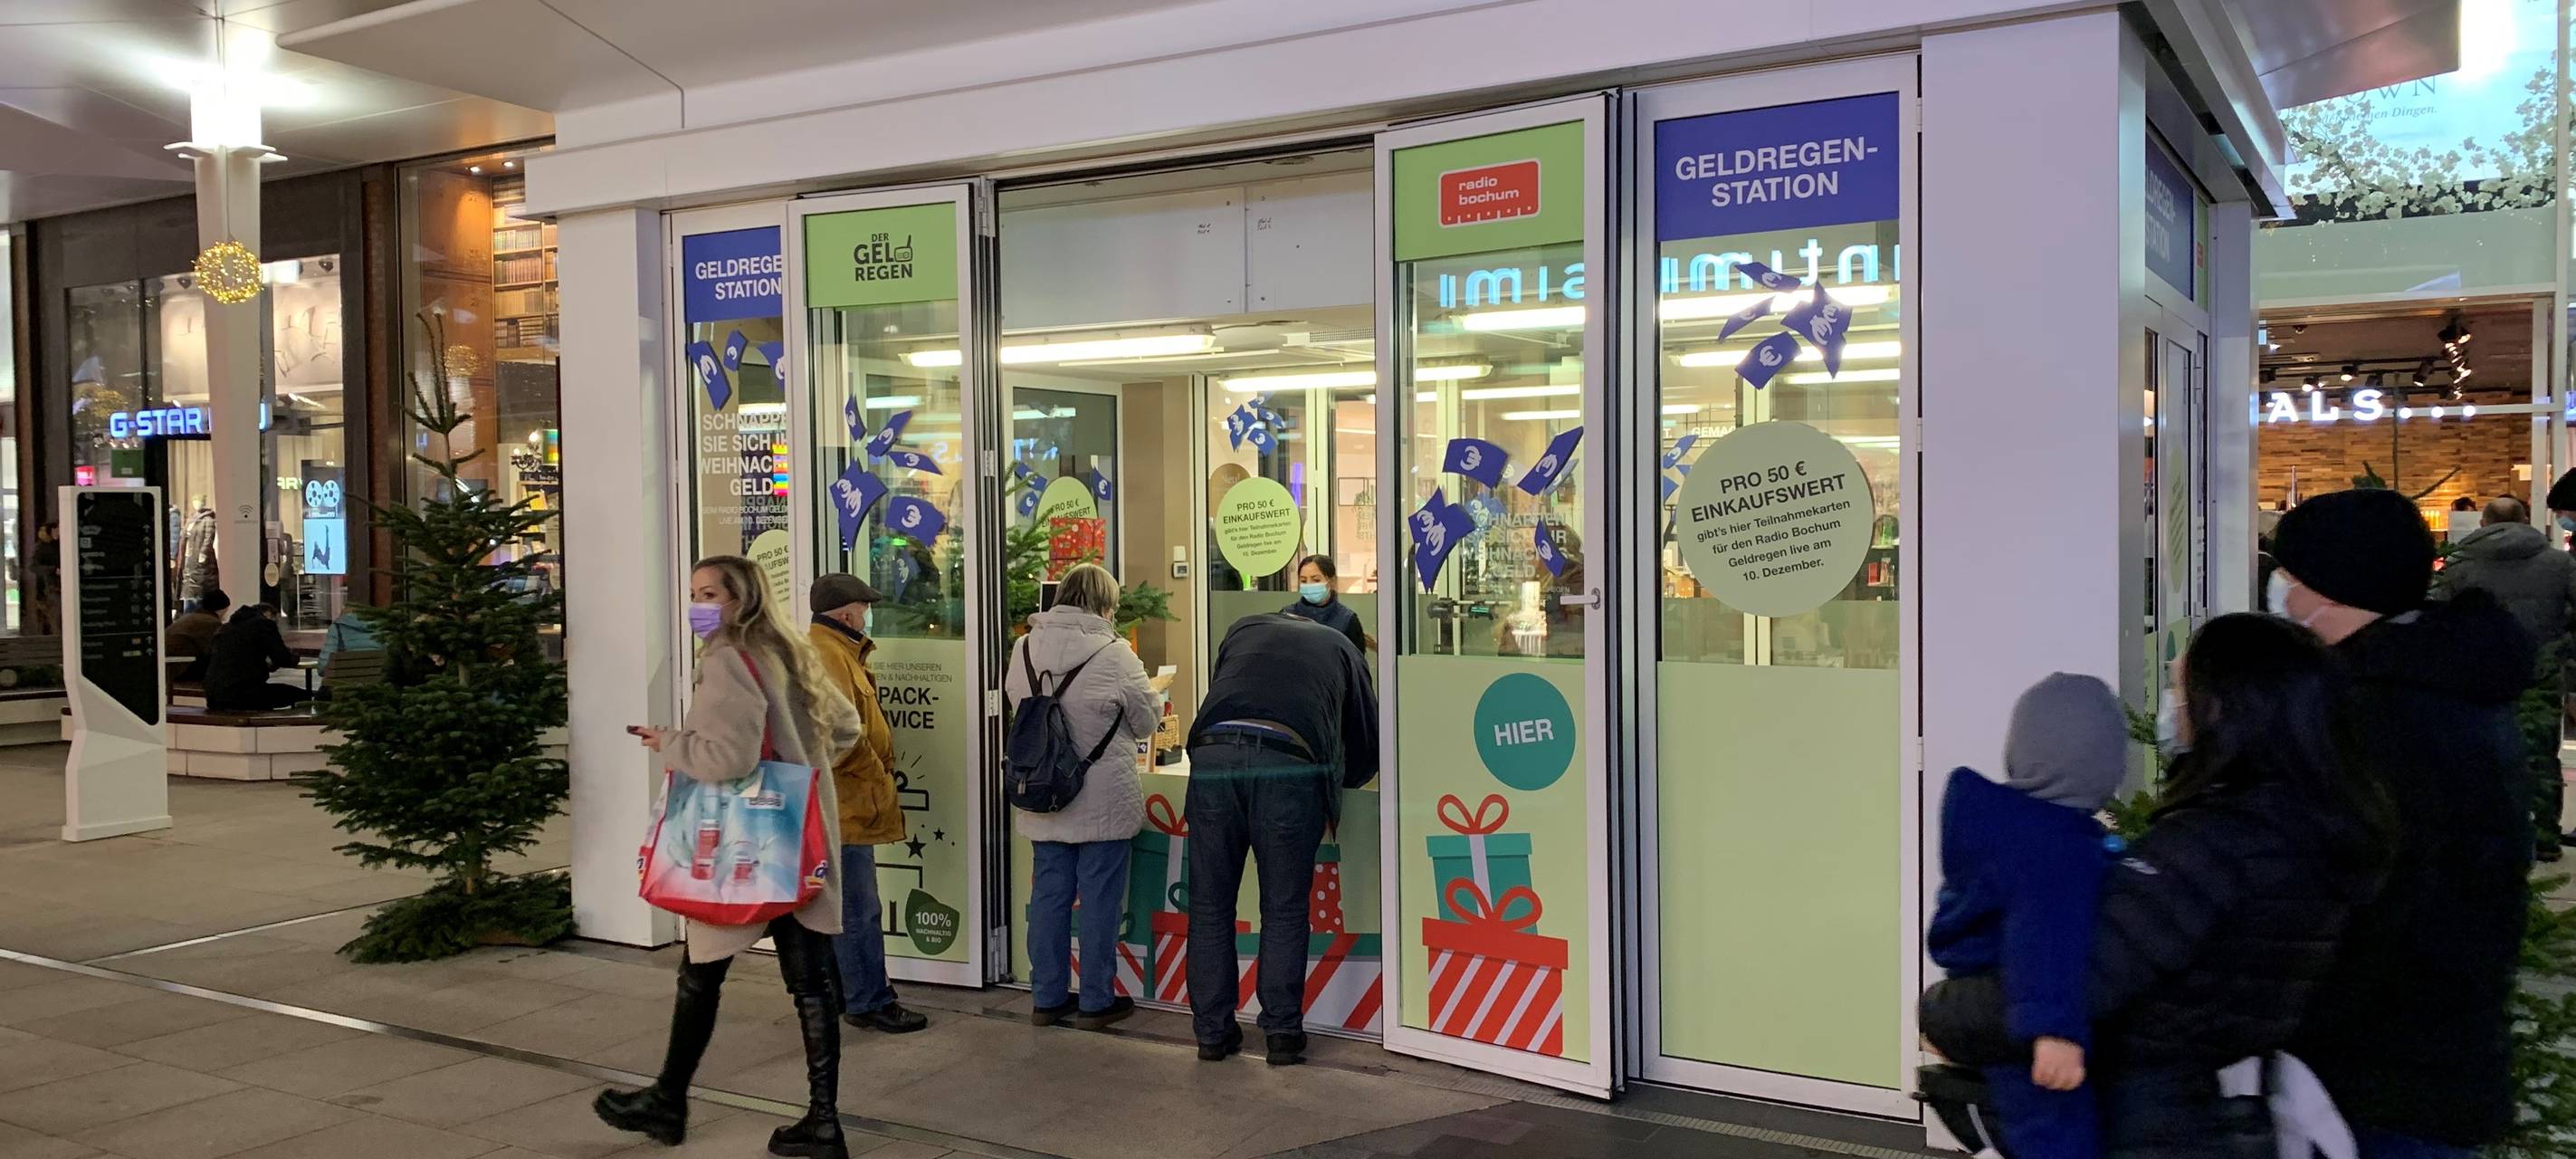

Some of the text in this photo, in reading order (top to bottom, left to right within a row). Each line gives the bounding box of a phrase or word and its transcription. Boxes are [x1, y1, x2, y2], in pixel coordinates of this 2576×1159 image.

[1675, 137, 1878, 180] GELDREGEN-
[1458, 177, 1498, 191] radio
[1712, 171, 1838, 207] STATION
[1458, 188, 1520, 206] bochum
[872, 233, 889, 242] DER
[695, 254, 782, 280] GELDREGE
[854, 263, 913, 282] REGEN
[715, 278, 782, 301] STATION
[2268, 389, 2476, 423] ALS...
[110, 407, 203, 439] G-STAR
[702, 412, 787, 431] SCHNAPP
[702, 436, 728, 453] SIE
[732, 434, 770, 451] SICH
[701, 455, 772, 475] WEIHNAC
[1721, 461, 1808, 493] PRO 50 €
[1236, 499, 1274, 512] PRO 50 €
[1691, 474, 1846, 522] EINKAUFSWERT
[1223, 508, 1291, 524] EINKAUFSWERT
[1730, 520, 1751, 535] hier
[1754, 501, 1851, 528] Teilnahmekarten
[1713, 520, 1841, 554] für den Radio Bochum
[774, 547, 783, 557] 50
[1728, 539, 1832, 568] Geldregen live am
[1743, 558, 1825, 581] 10. Dezember.
[878, 686, 939, 705] PACK-
[885, 710, 934, 729] VICE
[1493, 718, 1555, 747] HIER
[916, 912, 951, 927] 100%
